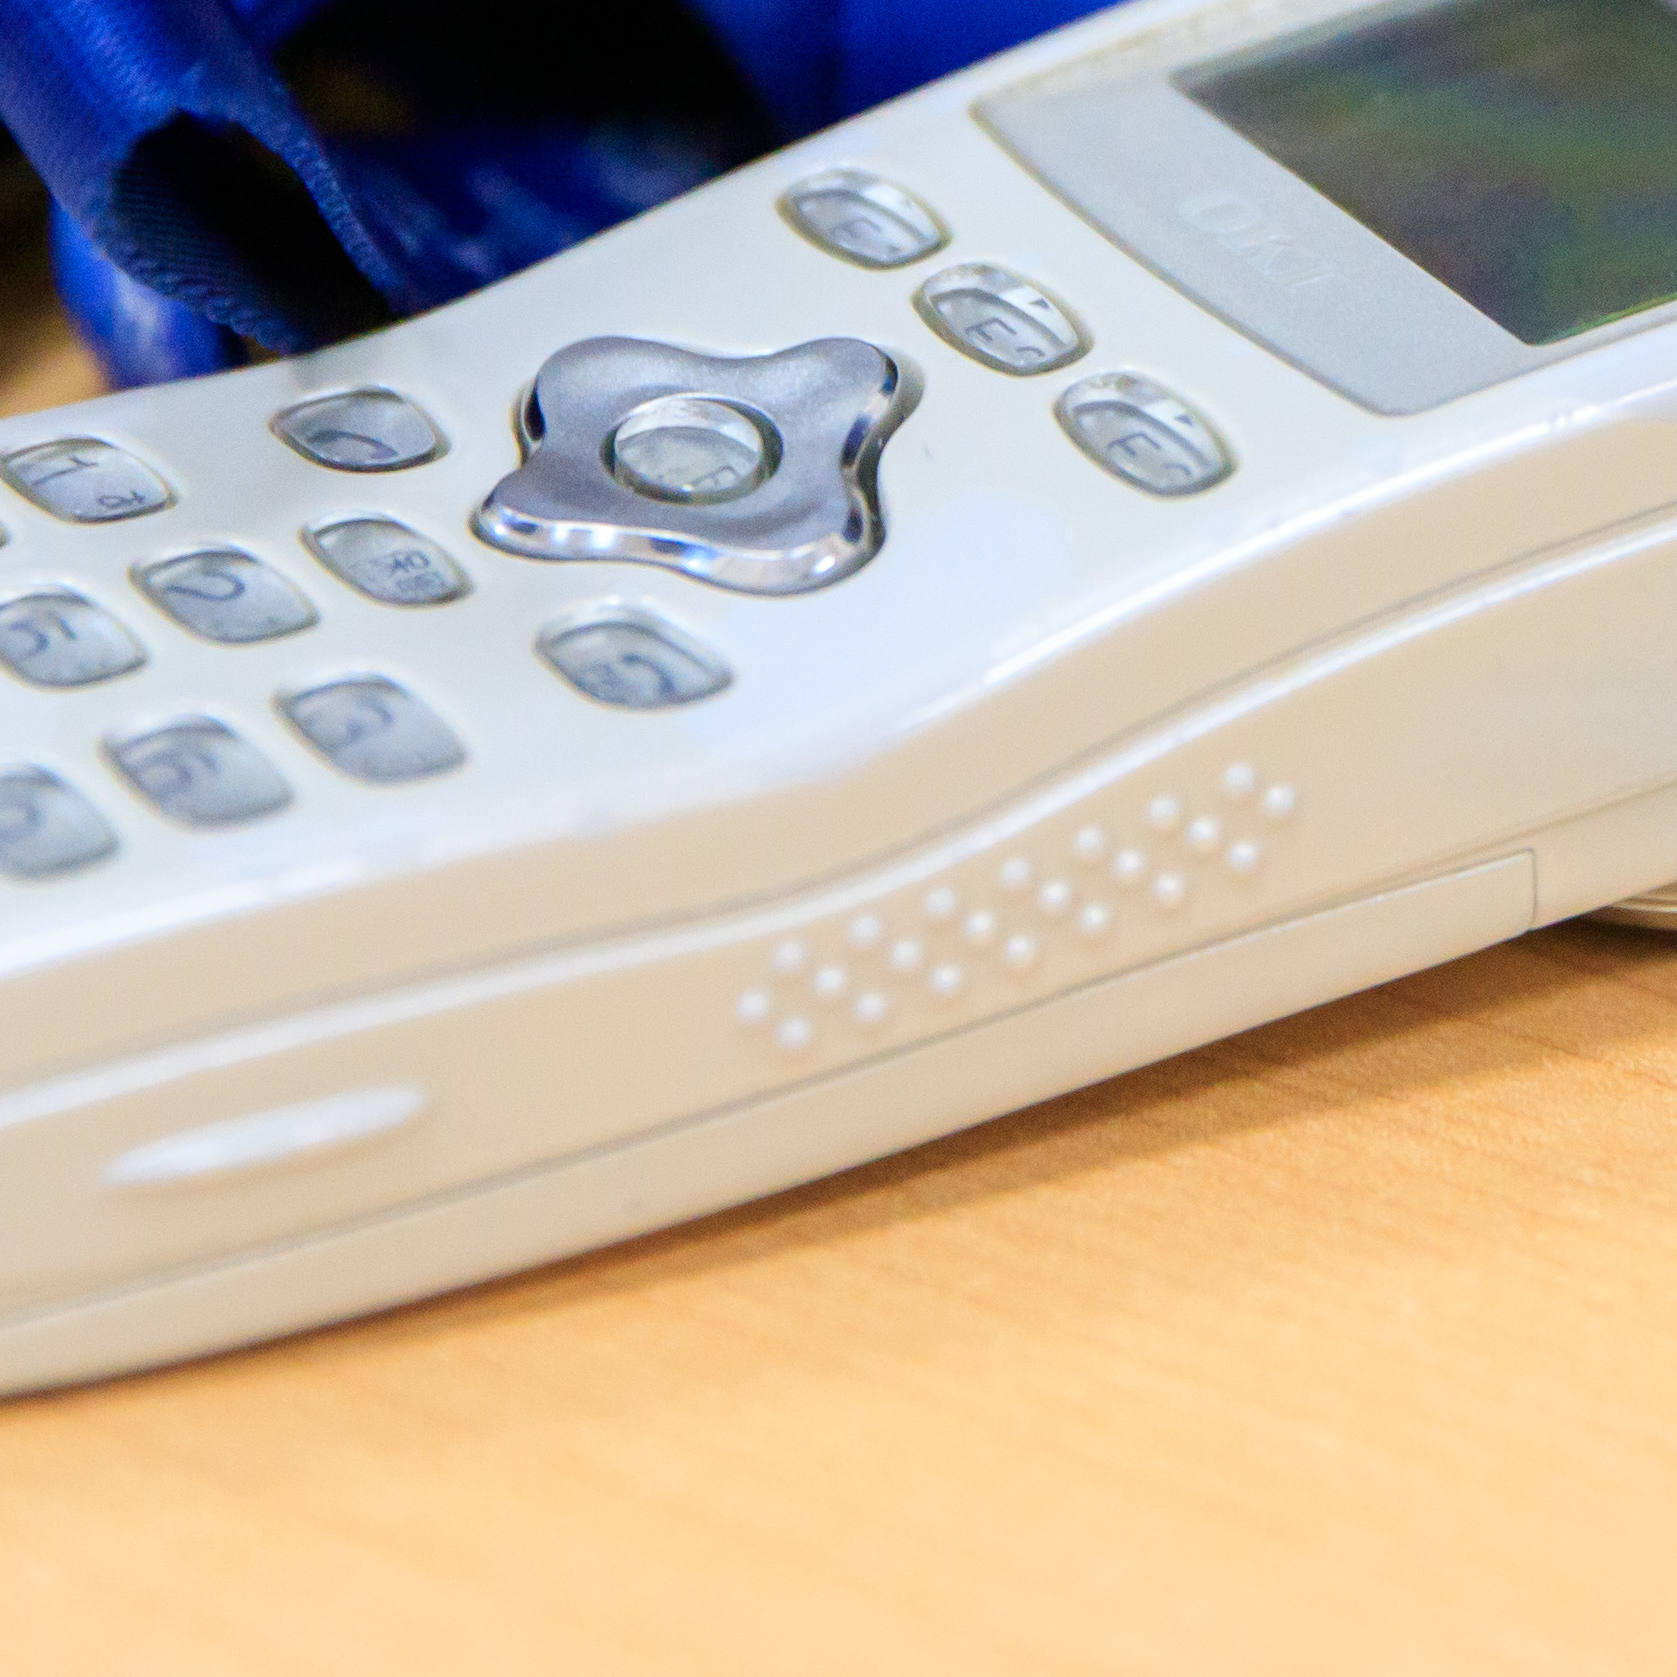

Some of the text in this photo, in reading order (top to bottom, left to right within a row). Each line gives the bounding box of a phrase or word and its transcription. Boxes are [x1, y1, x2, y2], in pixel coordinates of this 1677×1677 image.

[1178, 190, 1346, 298] OKI
[30, 454, 99, 487] 1
[164, 571, 246, 603] 2
